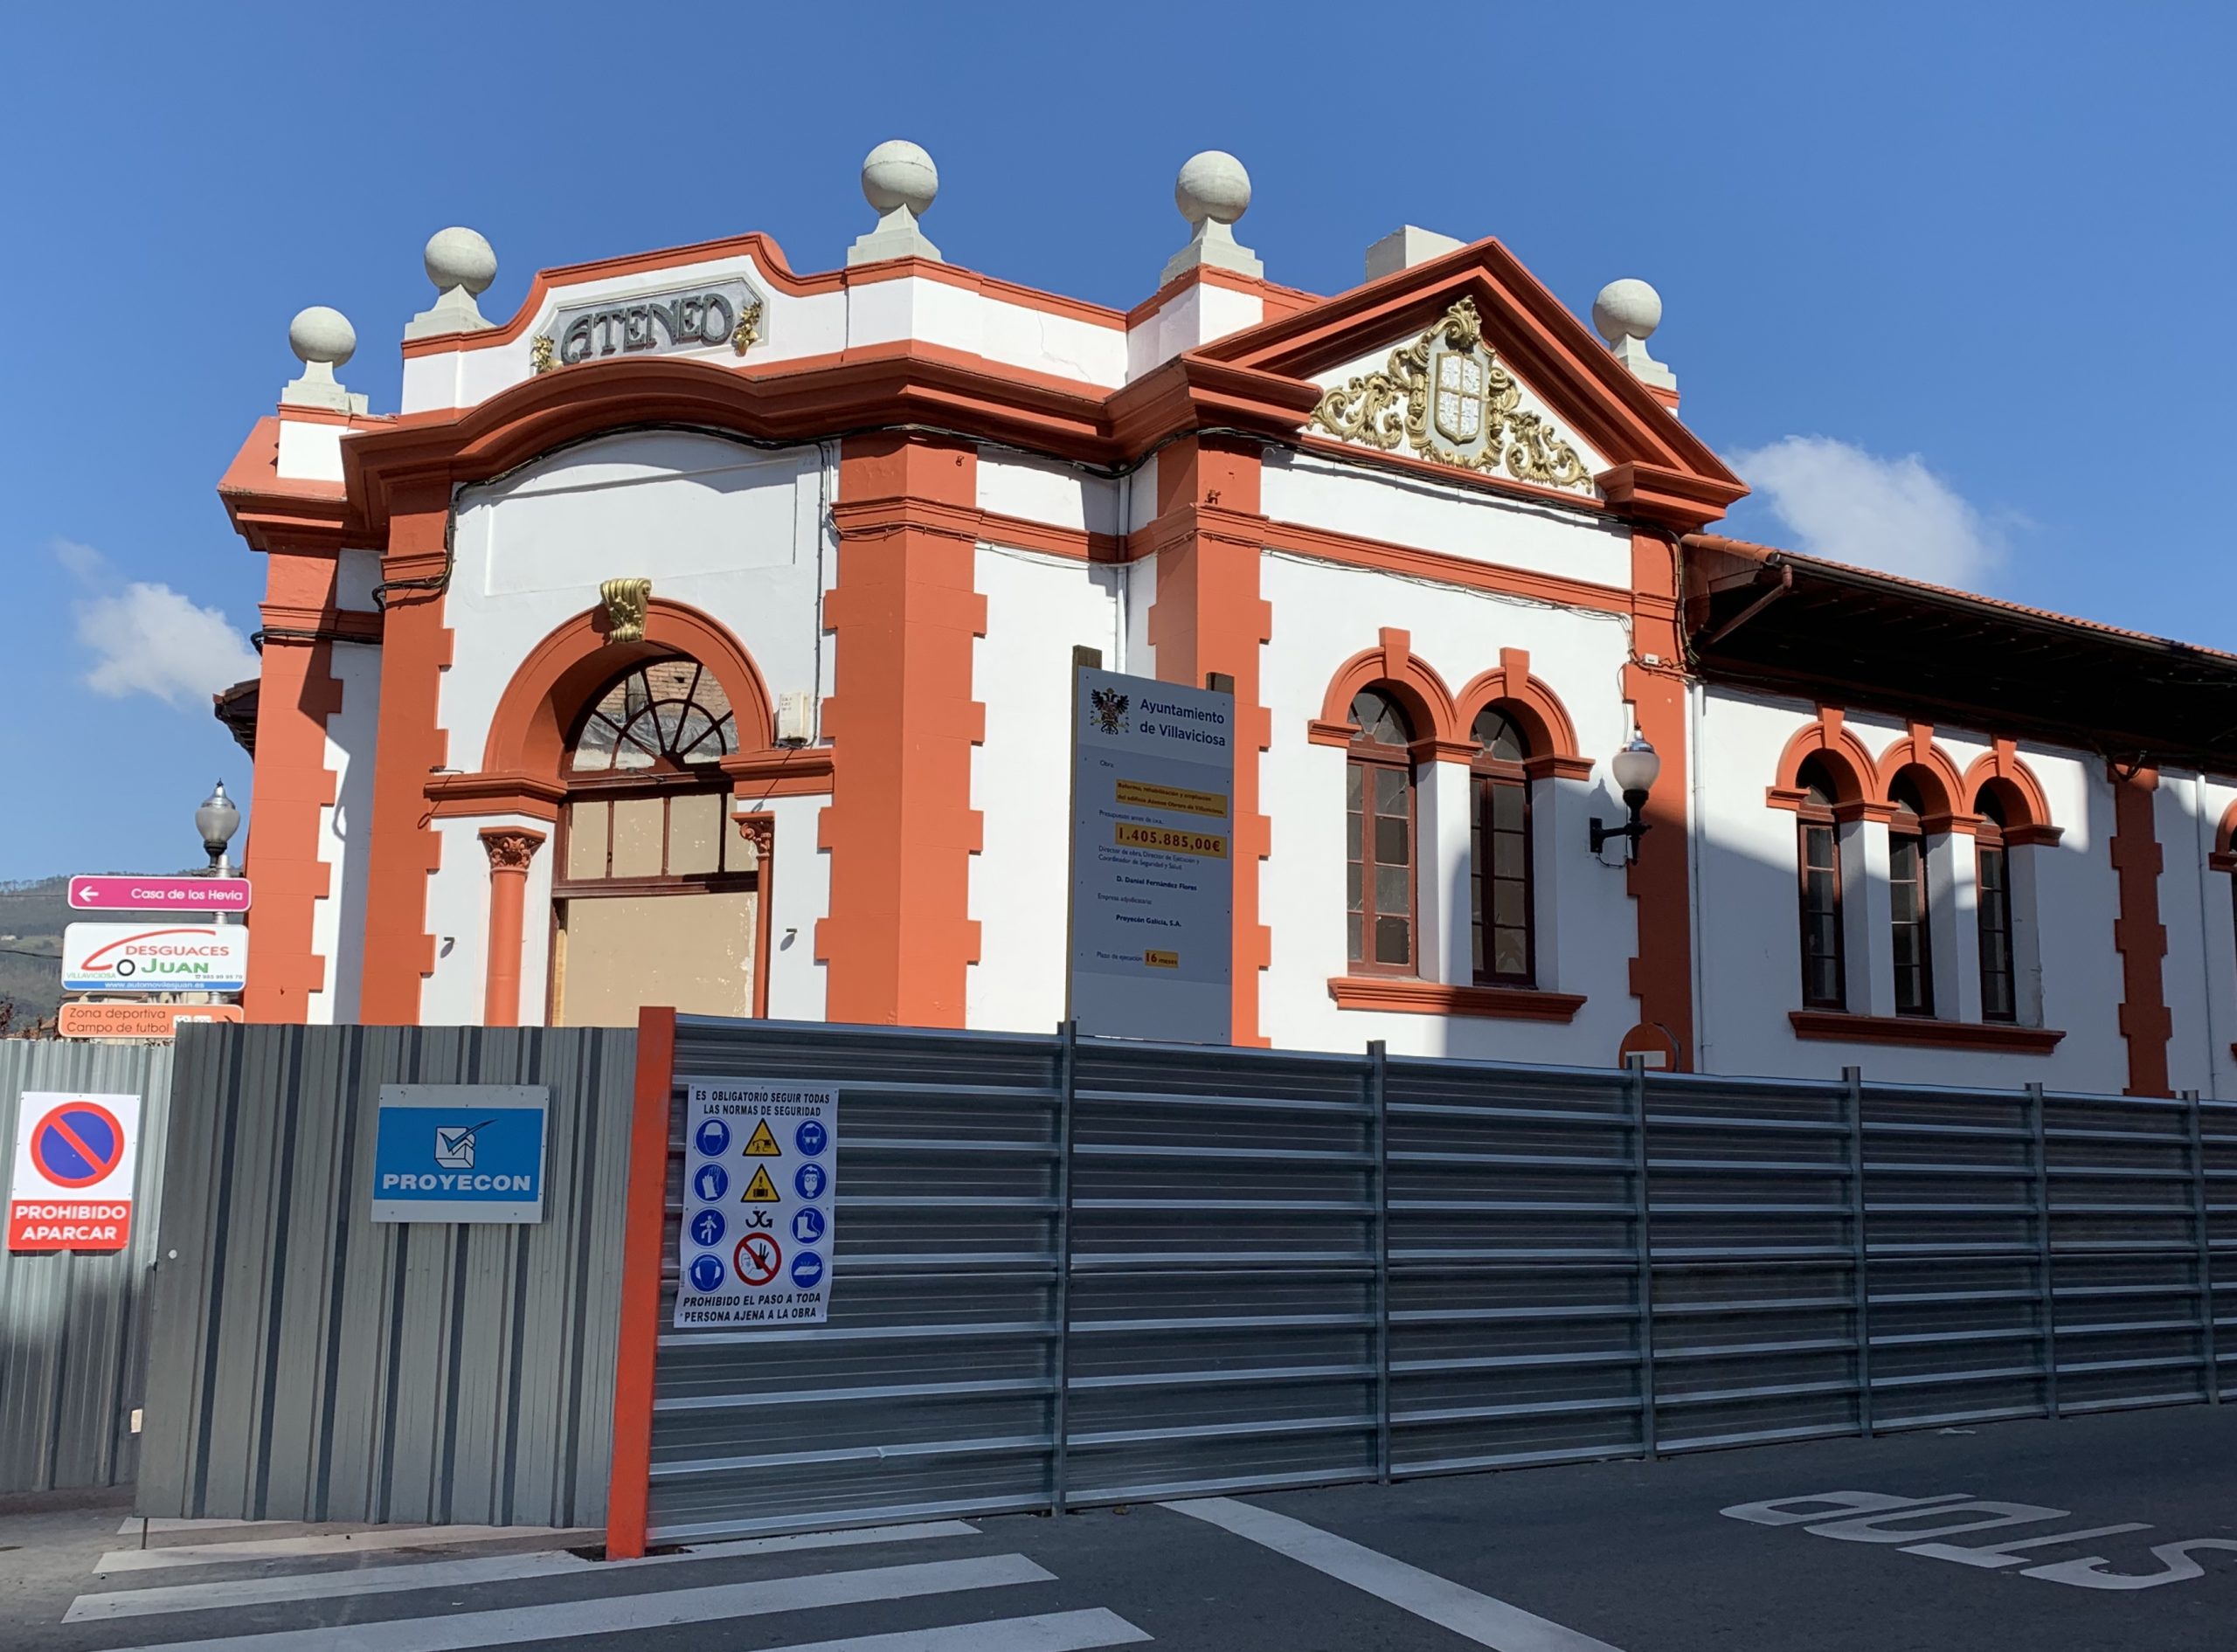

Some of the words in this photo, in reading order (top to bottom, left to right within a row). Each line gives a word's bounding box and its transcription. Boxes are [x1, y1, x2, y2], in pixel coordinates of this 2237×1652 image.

[561, 294, 734, 364] ATENEO
[1139, 699, 1224, 724] Ayuntamiento
[1139, 721, 1155, 734] de
[1159, 724, 1226, 746] Villaviciosa
[1118, 827, 1221, 852] 1.405.885,00€
[1143, 851, 1164, 860] Director
[1125, 876, 1145, 885] Daniel
[1146, 879, 1177, 889] Fernández
[1179, 882, 1197, 891] Flores
[131, 888, 164, 899] Casa
[168, 888, 184, 900] de
[188, 889, 205, 901] los
[208, 889, 244, 902] Hevia
[1116, 914, 1145, 924] Proyecón
[1146, 917, 1168, 926] Galicia,
[125, 945, 230, 957] DESGUACES
[1146, 952, 1158, 963] 16
[141, 958, 209, 974] JUAN
[70, 1007, 101, 1019] Zona
[105, 1008, 166, 1020] deportiva
[66, 1021, 113, 1034] Campo
[115, 1022, 133, 1033] de
[136, 1022, 170, 1033] futbol
[696, 1090, 707, 1101] ES
[711, 1091, 769, 1102] OBLIGATORIO
[771, 1093, 801, 1103] SEGUIR
[804, 1094, 830, 1104] TODAS
[703, 1104, 720, 1115] LAS
[723, 1105, 758, 1116] NORMAS
[760, 1105, 772, 1116] DE
[774, 1105, 821, 1116] SEGURIDAD
[383, 1173, 531, 1192] PROYECON
[15, 1206, 127, 1220] PROHIBIDO
[21, 1227, 117, 1241] APARCAR
[682, 1296, 740, 1307] PROHIBIDO
[743, 1295, 755, 1306] EL
[758, 1294, 784, 1305] PASO
[786, 1293, 793, 1303] A
[796, 1292, 821, 1303] TODA
[684, 1310, 731, 1323] PERSONA
[733, 1310, 765, 1321] AJENA
[767, 1310, 774, 1319] A
[777, 1309, 788, 1319] LA
[793, 1308, 816, 1318] OBRA
